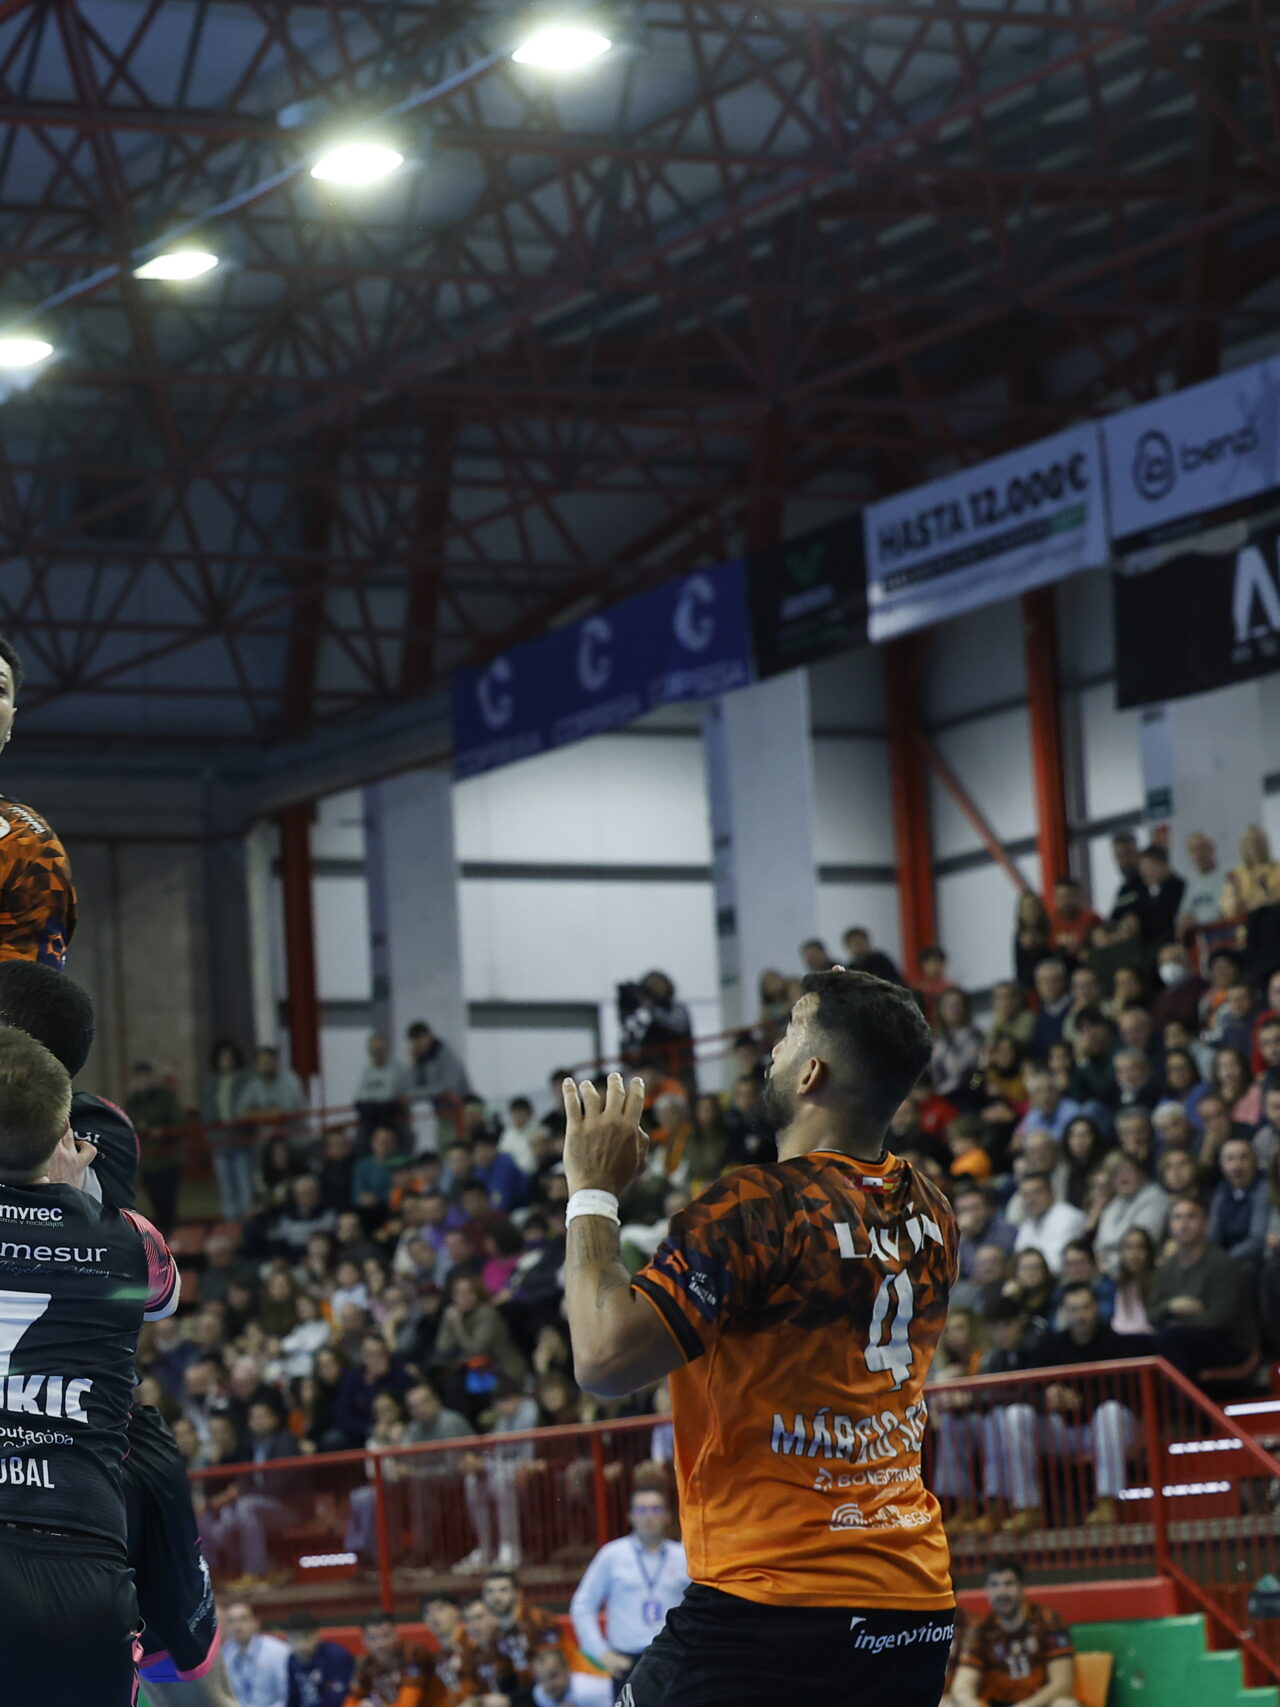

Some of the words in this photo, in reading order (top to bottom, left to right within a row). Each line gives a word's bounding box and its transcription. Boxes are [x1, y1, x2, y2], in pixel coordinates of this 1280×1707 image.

[877, 495, 963, 564] HASTA
[969, 450, 1090, 530] 12.000€
[863, 1269, 914, 1392] 4
